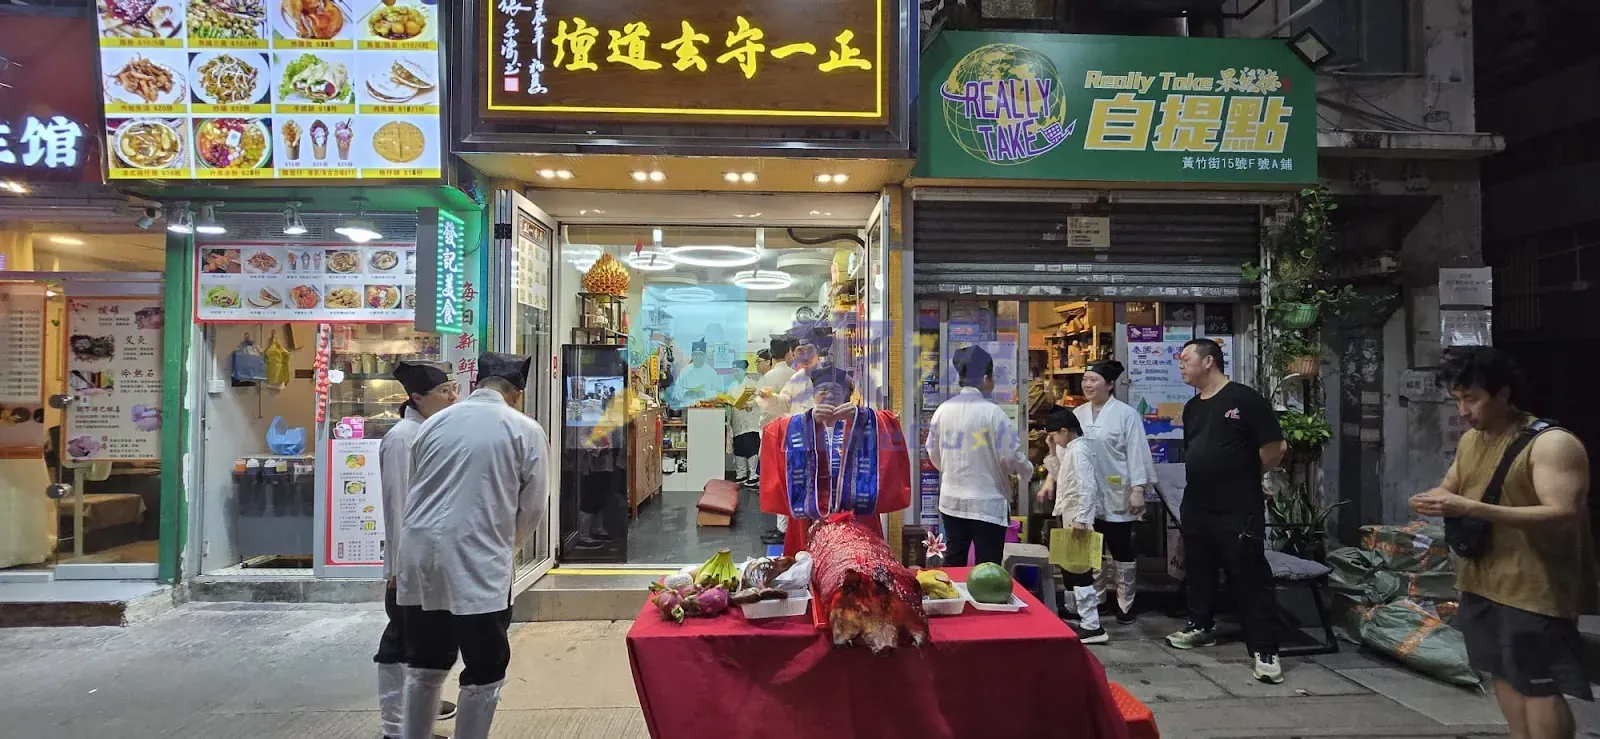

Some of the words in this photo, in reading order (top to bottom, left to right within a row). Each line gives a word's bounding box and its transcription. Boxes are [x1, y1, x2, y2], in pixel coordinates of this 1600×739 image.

[965, 78, 1051, 119] REALLY
[1085, 70, 1156, 94] Really
[1160, 72, 1213, 91] Take
[977, 118, 1037, 161] TAKE
[1084, 92, 1293, 153] 自提點
[1182, 156, 1294, 171] 黃竹街15號F號A鋪
[440, 221, 458, 325] 發記美食
[455, 281, 478, 395] 每日新鮮
